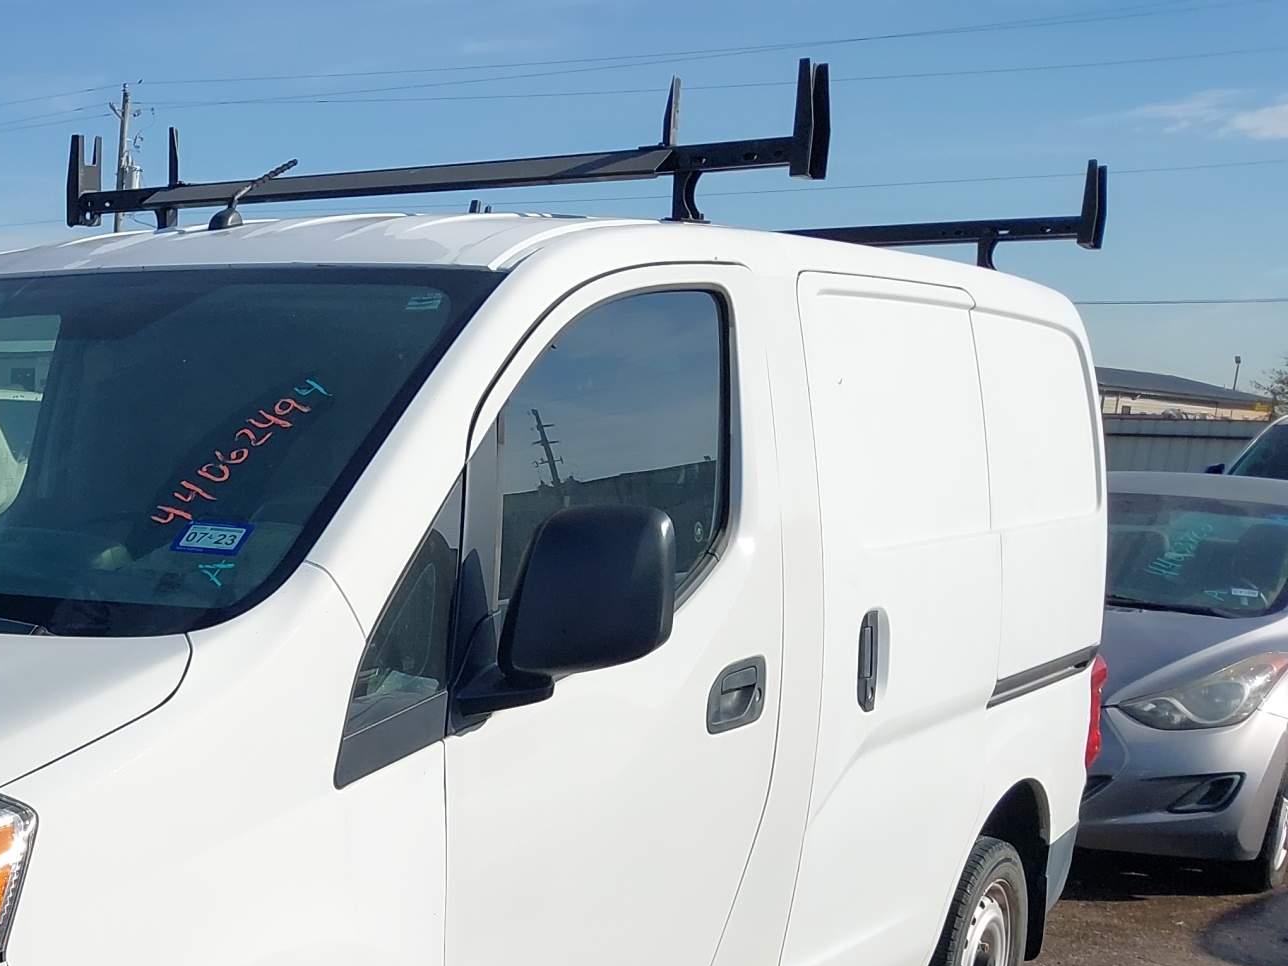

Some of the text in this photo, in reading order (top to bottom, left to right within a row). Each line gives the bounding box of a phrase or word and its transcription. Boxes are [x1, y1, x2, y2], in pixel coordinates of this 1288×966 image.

[151, 377, 333, 523] 44062494
[185, 531, 238, 546] 07 23
